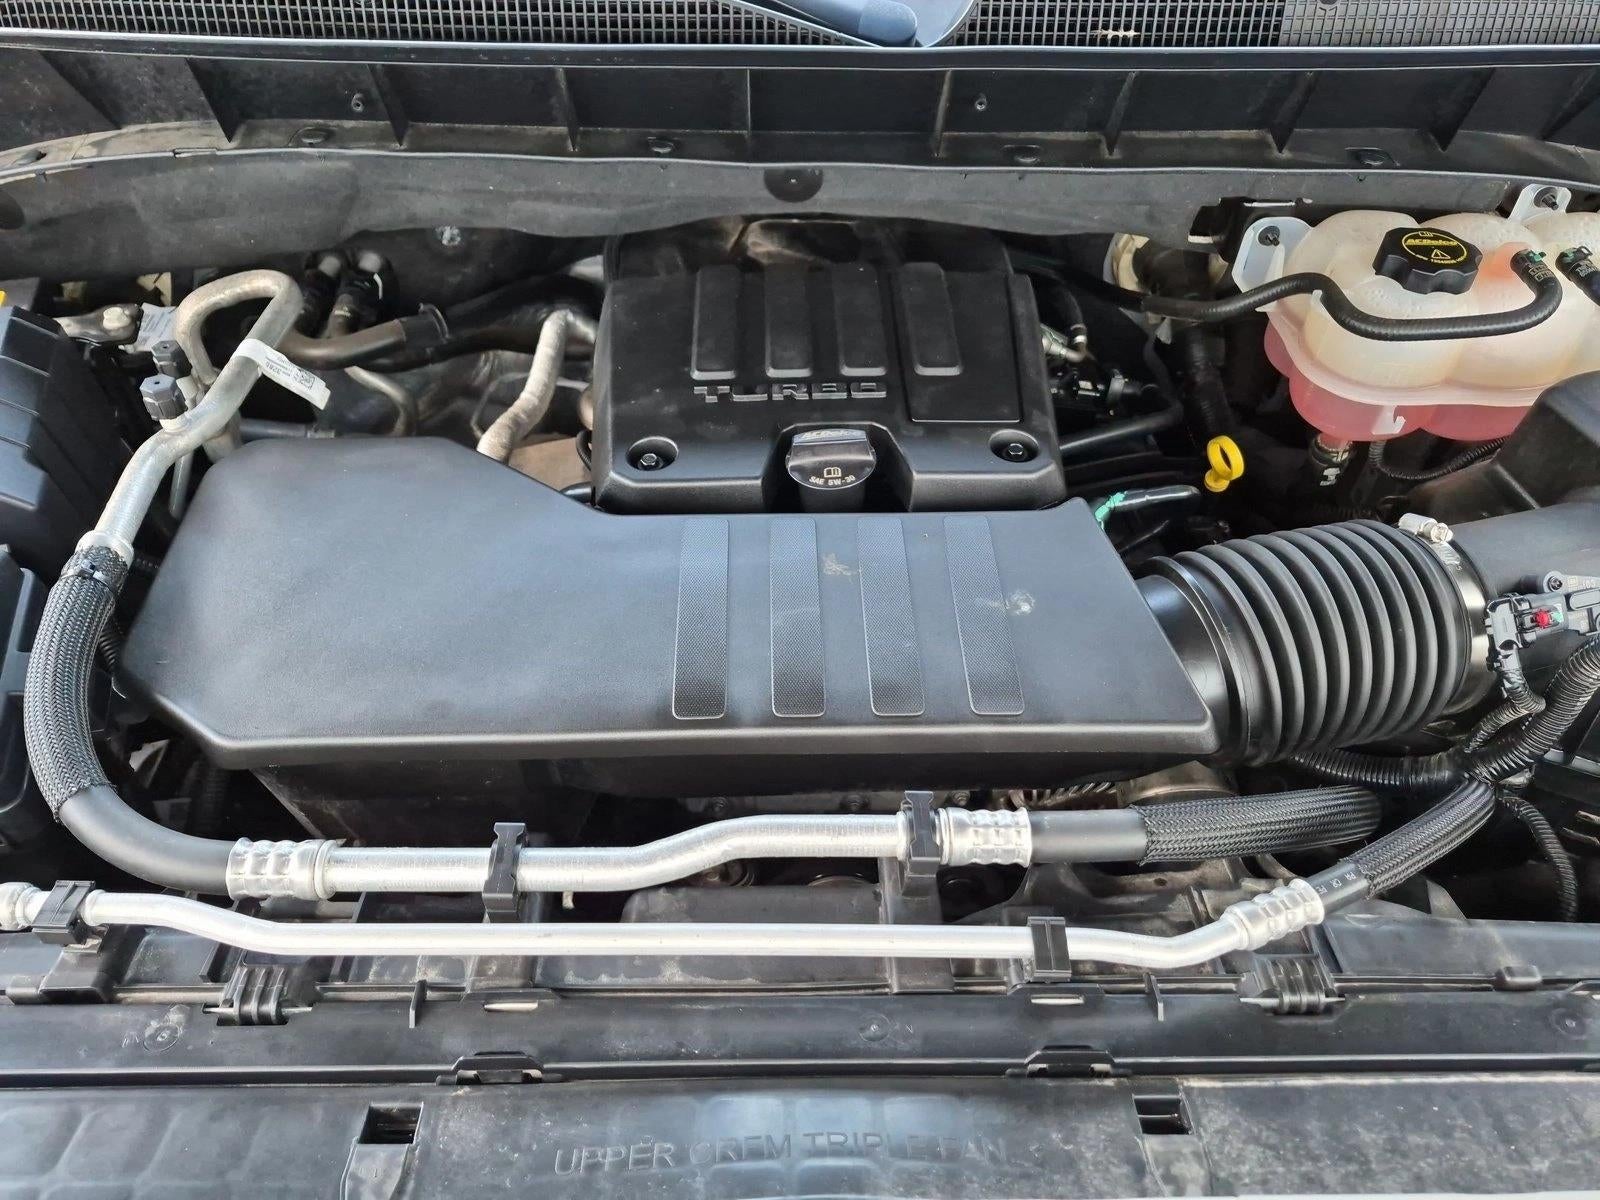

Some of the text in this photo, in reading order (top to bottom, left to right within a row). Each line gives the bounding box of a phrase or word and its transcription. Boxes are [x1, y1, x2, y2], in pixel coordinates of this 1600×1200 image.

[693, 382, 887, 403] TURBO
[808, 475, 857, 486] SAE 5W-30
[554, 1142, 675, 1175] UPPER
